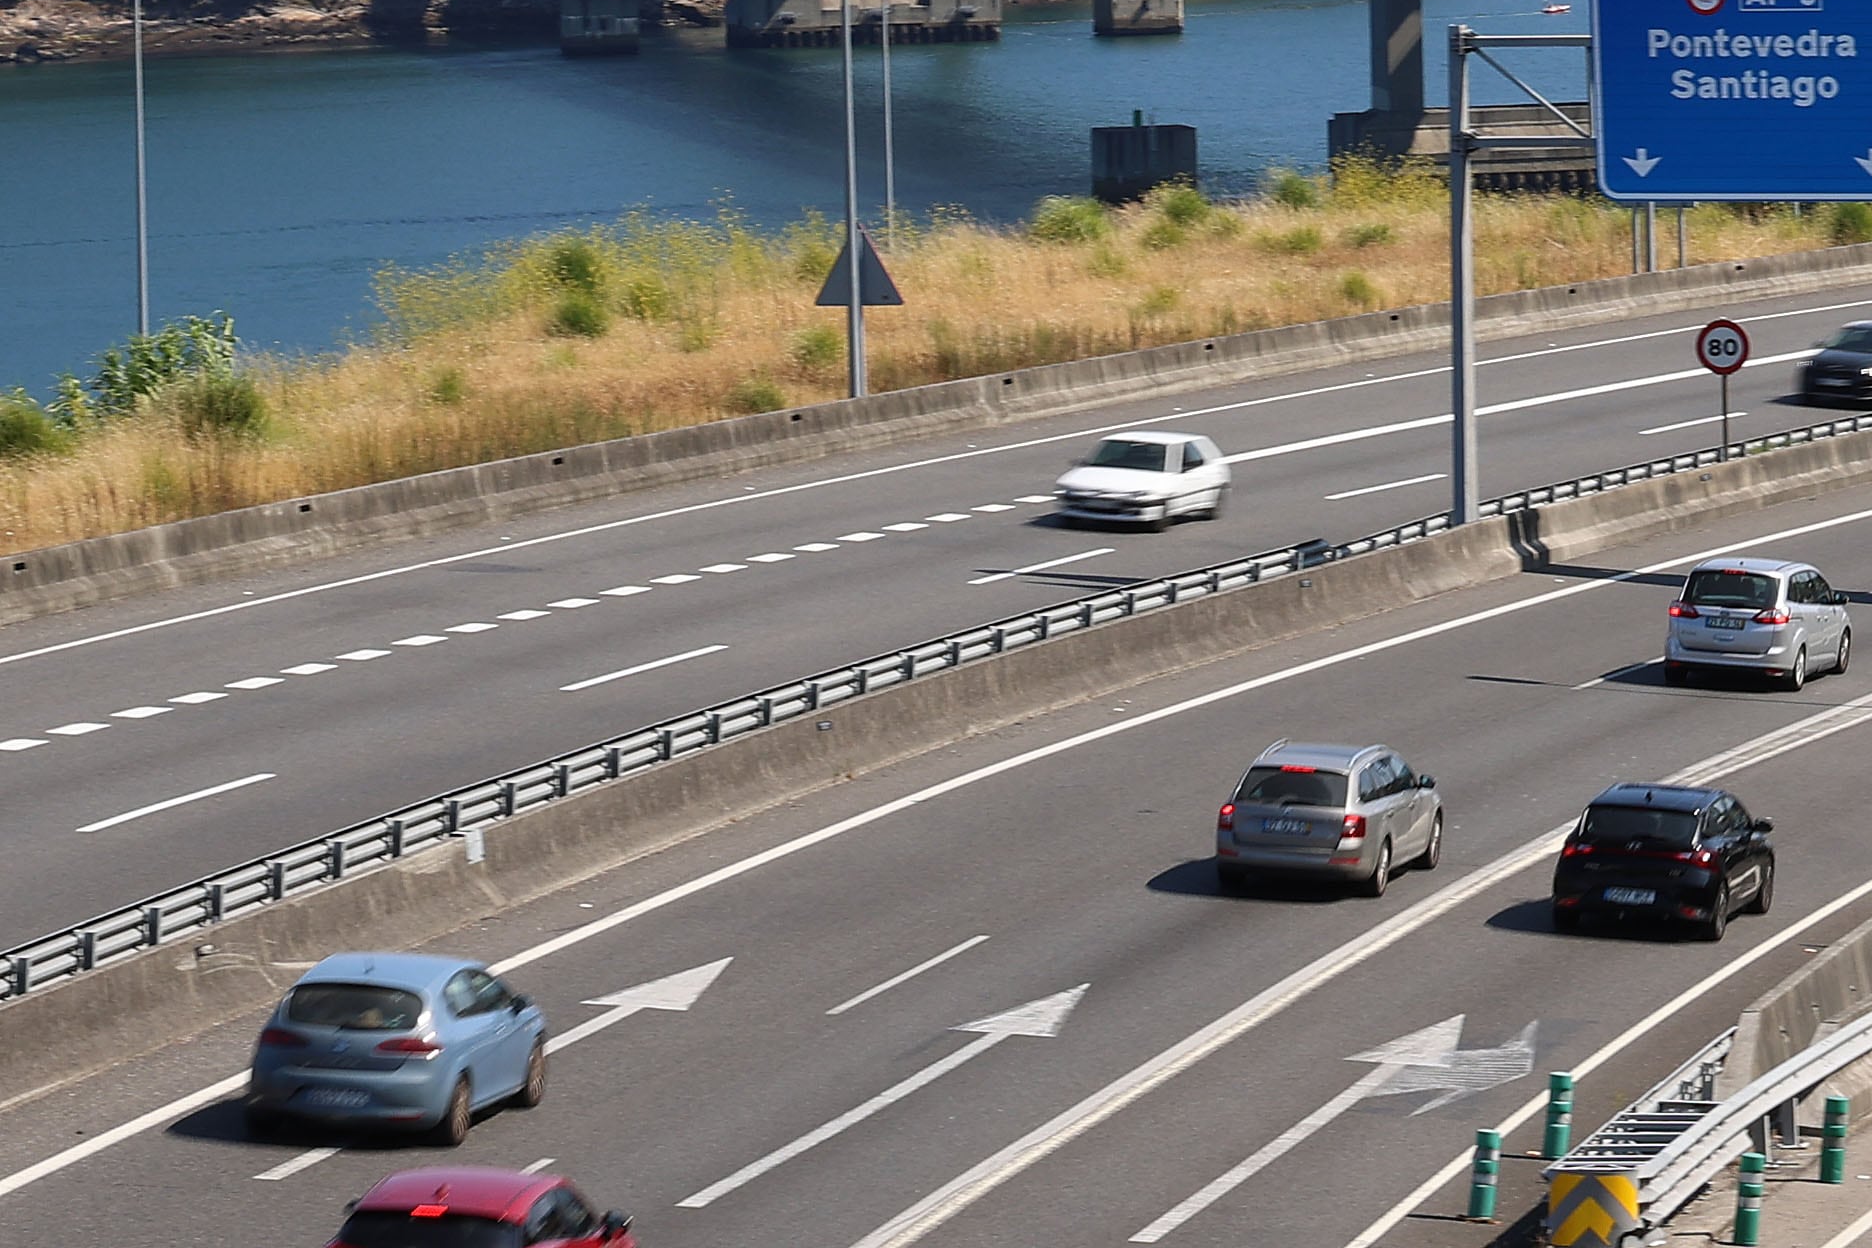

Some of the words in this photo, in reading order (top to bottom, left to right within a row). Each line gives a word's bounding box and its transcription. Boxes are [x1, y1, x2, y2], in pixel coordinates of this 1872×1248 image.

[1648, 28, 1857, 58] Pontevedra
[1670, 69, 1839, 107] Santiago
[1708, 339, 1738, 356] 80
